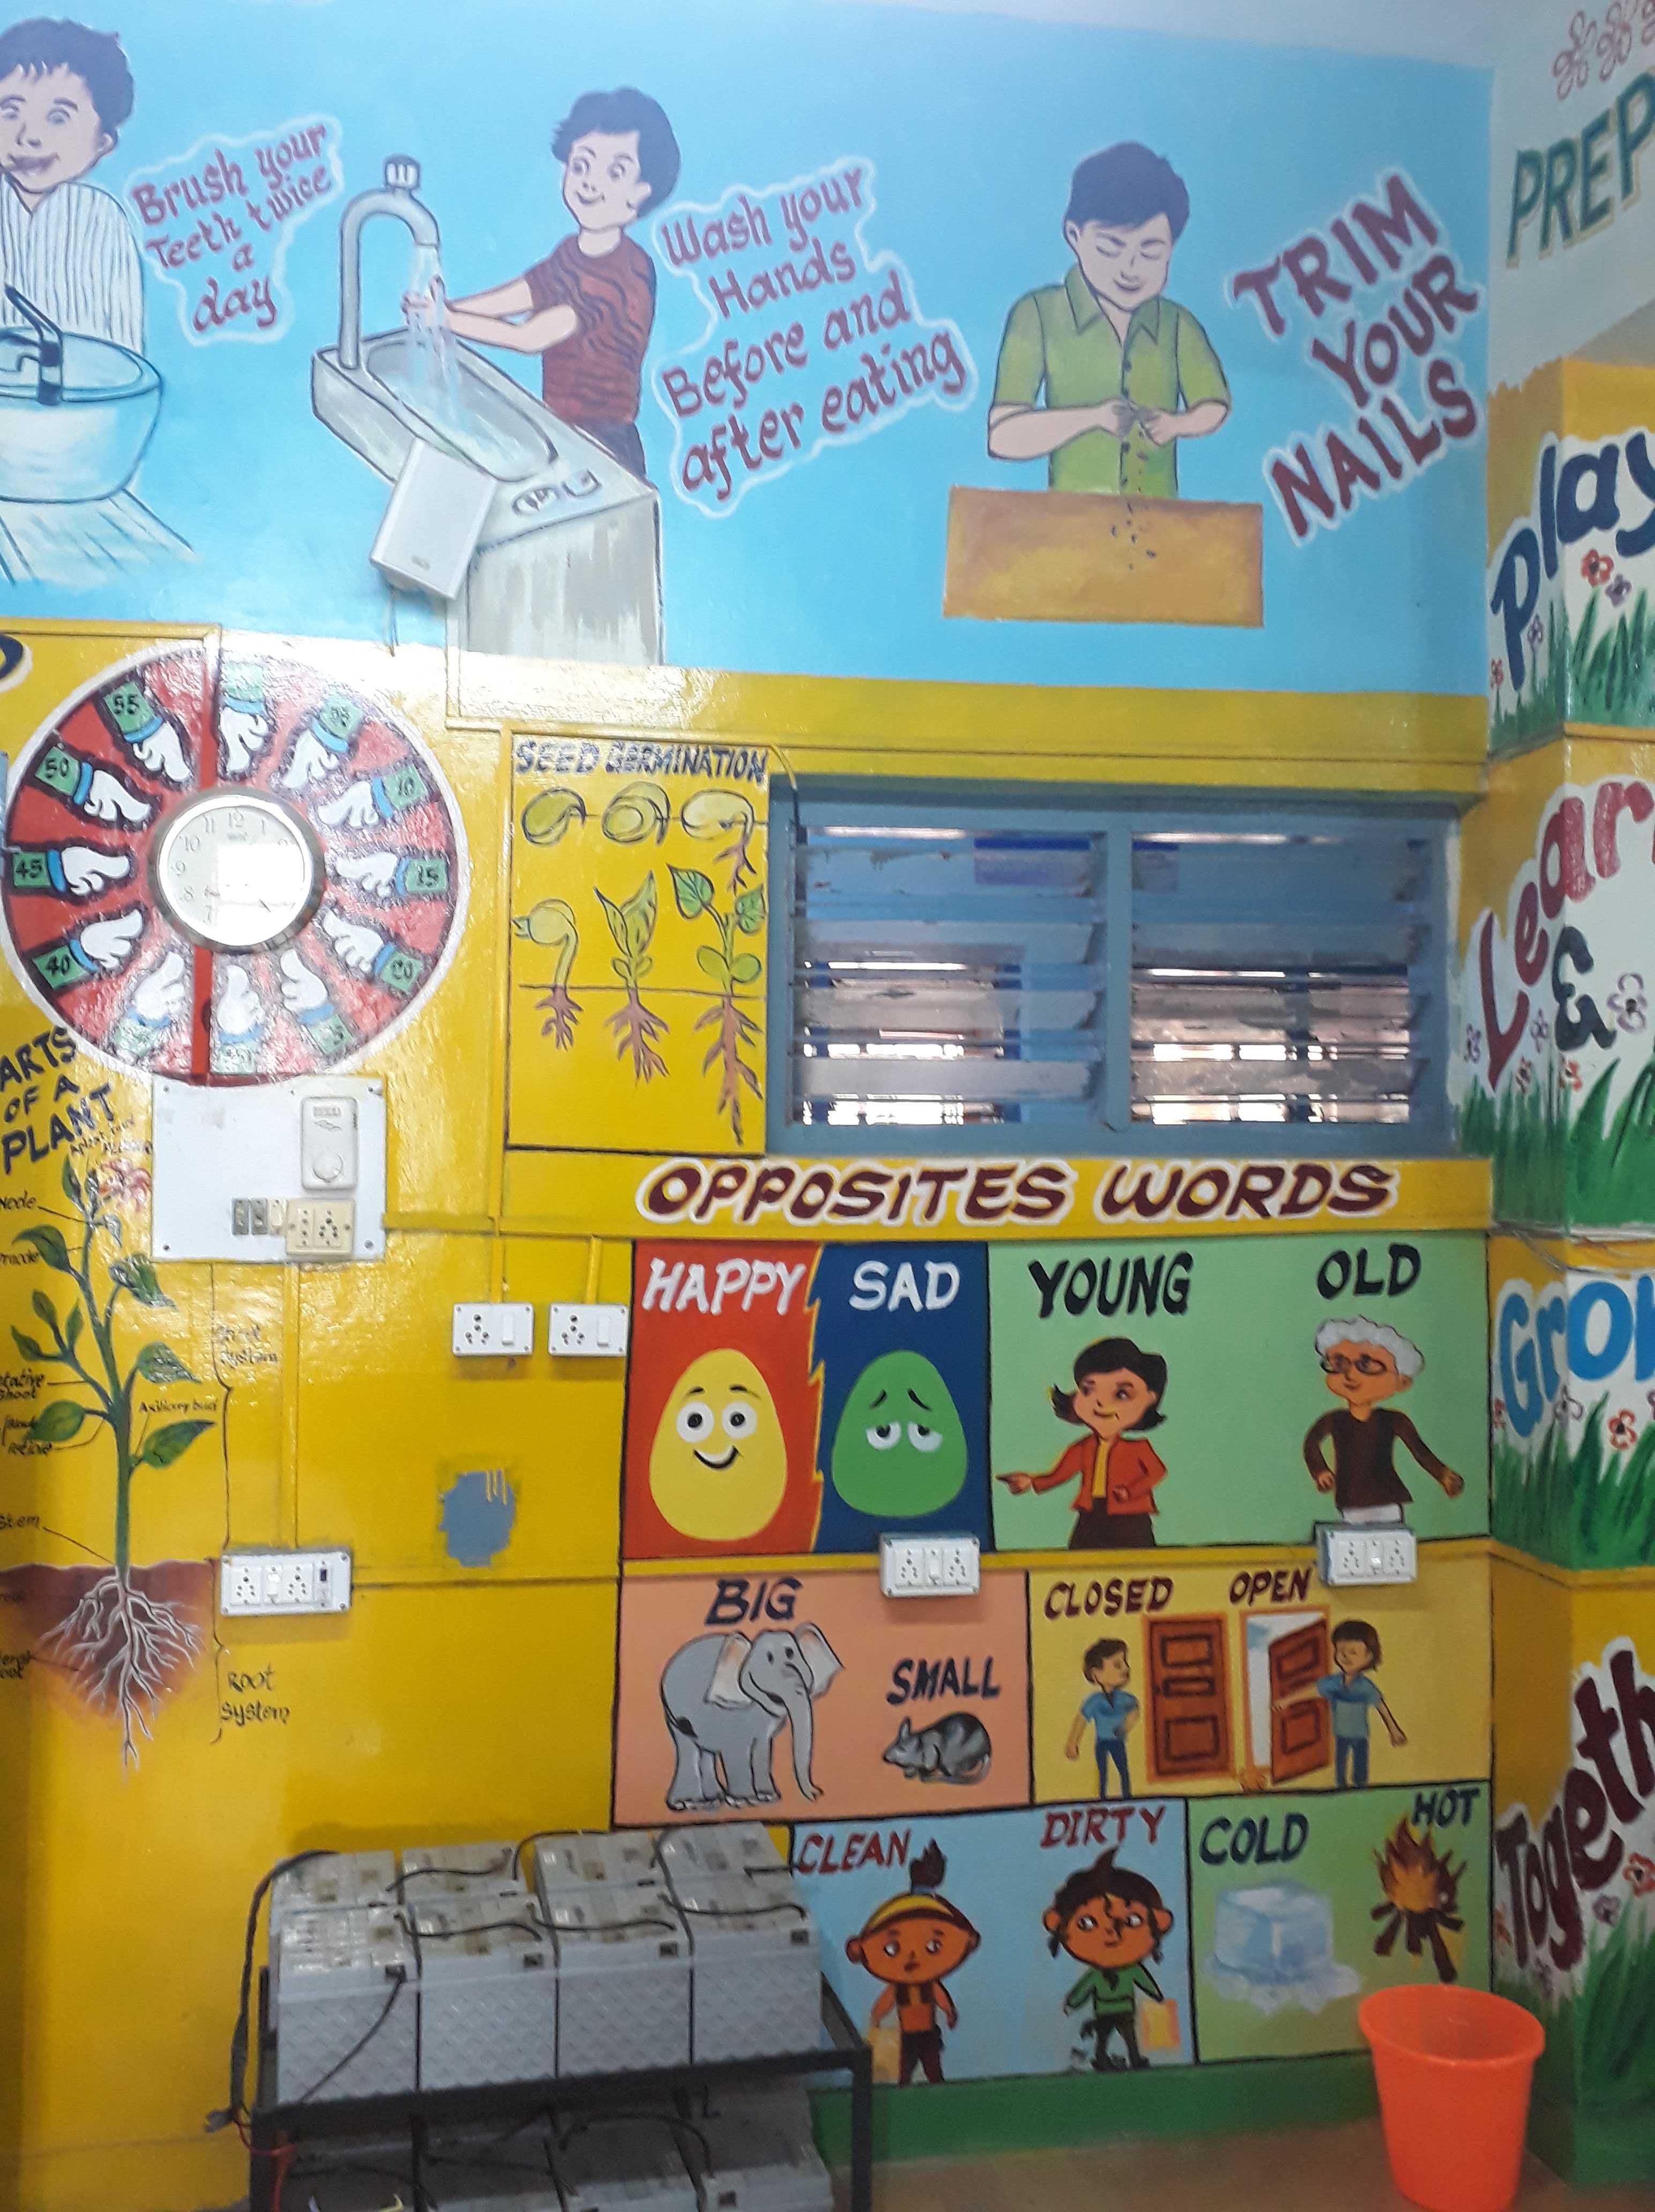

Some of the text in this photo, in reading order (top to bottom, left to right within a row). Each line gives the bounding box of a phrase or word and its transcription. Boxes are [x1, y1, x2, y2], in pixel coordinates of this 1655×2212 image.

[132, 123, 326, 226] Brush your
[145, 166, 332, 270] Teeth twice
[660, 167, 861, 266] Wash your
[230, 242, 254, 272] a
[708, 236, 856, 320] Hands
[1233, 174, 1437, 335] TRIM
[192, 275, 277, 333] day
[1311, 253, 1479, 408] YOUR
[662, 268, 912, 418] Before and
[682, 332, 966, 501] after eating
[1272, 358, 1478, 539] NAILS
[114, 694, 140, 716] 55
[44, 758, 69, 780] 50
[515, 740, 767, 783] SEED GERMINATION
[15, 860, 42, 879] 45
[185, 836, 200, 853] 10
[1480, 781, 1655, 1093] Lear
[45, 956, 71, 976] 40
[4, 1074, 80, 1123] OF A
[2, 1083, 114, 1176] PLANT
[645, 1164, 1395, 1222] OPPOSITES WORDS
[642, 1258, 960, 1316] HAPPY SAD
[1027, 1243, 1421, 1318] YOUNG OLD
[704, 1578, 802, 1625] BIG
[1045, 1566, 1314, 1620] CLOSED OPEN
[227, 1662, 275, 1693] Root
[886, 1656, 1001, 1705] SMALL
[1040, 1805, 1167, 1849] DIRTY
[1412, 1788, 1480, 1828] HOT
[797, 1829, 912, 1875] CLEAN
[1199, 1813, 1309, 1866] COLD
